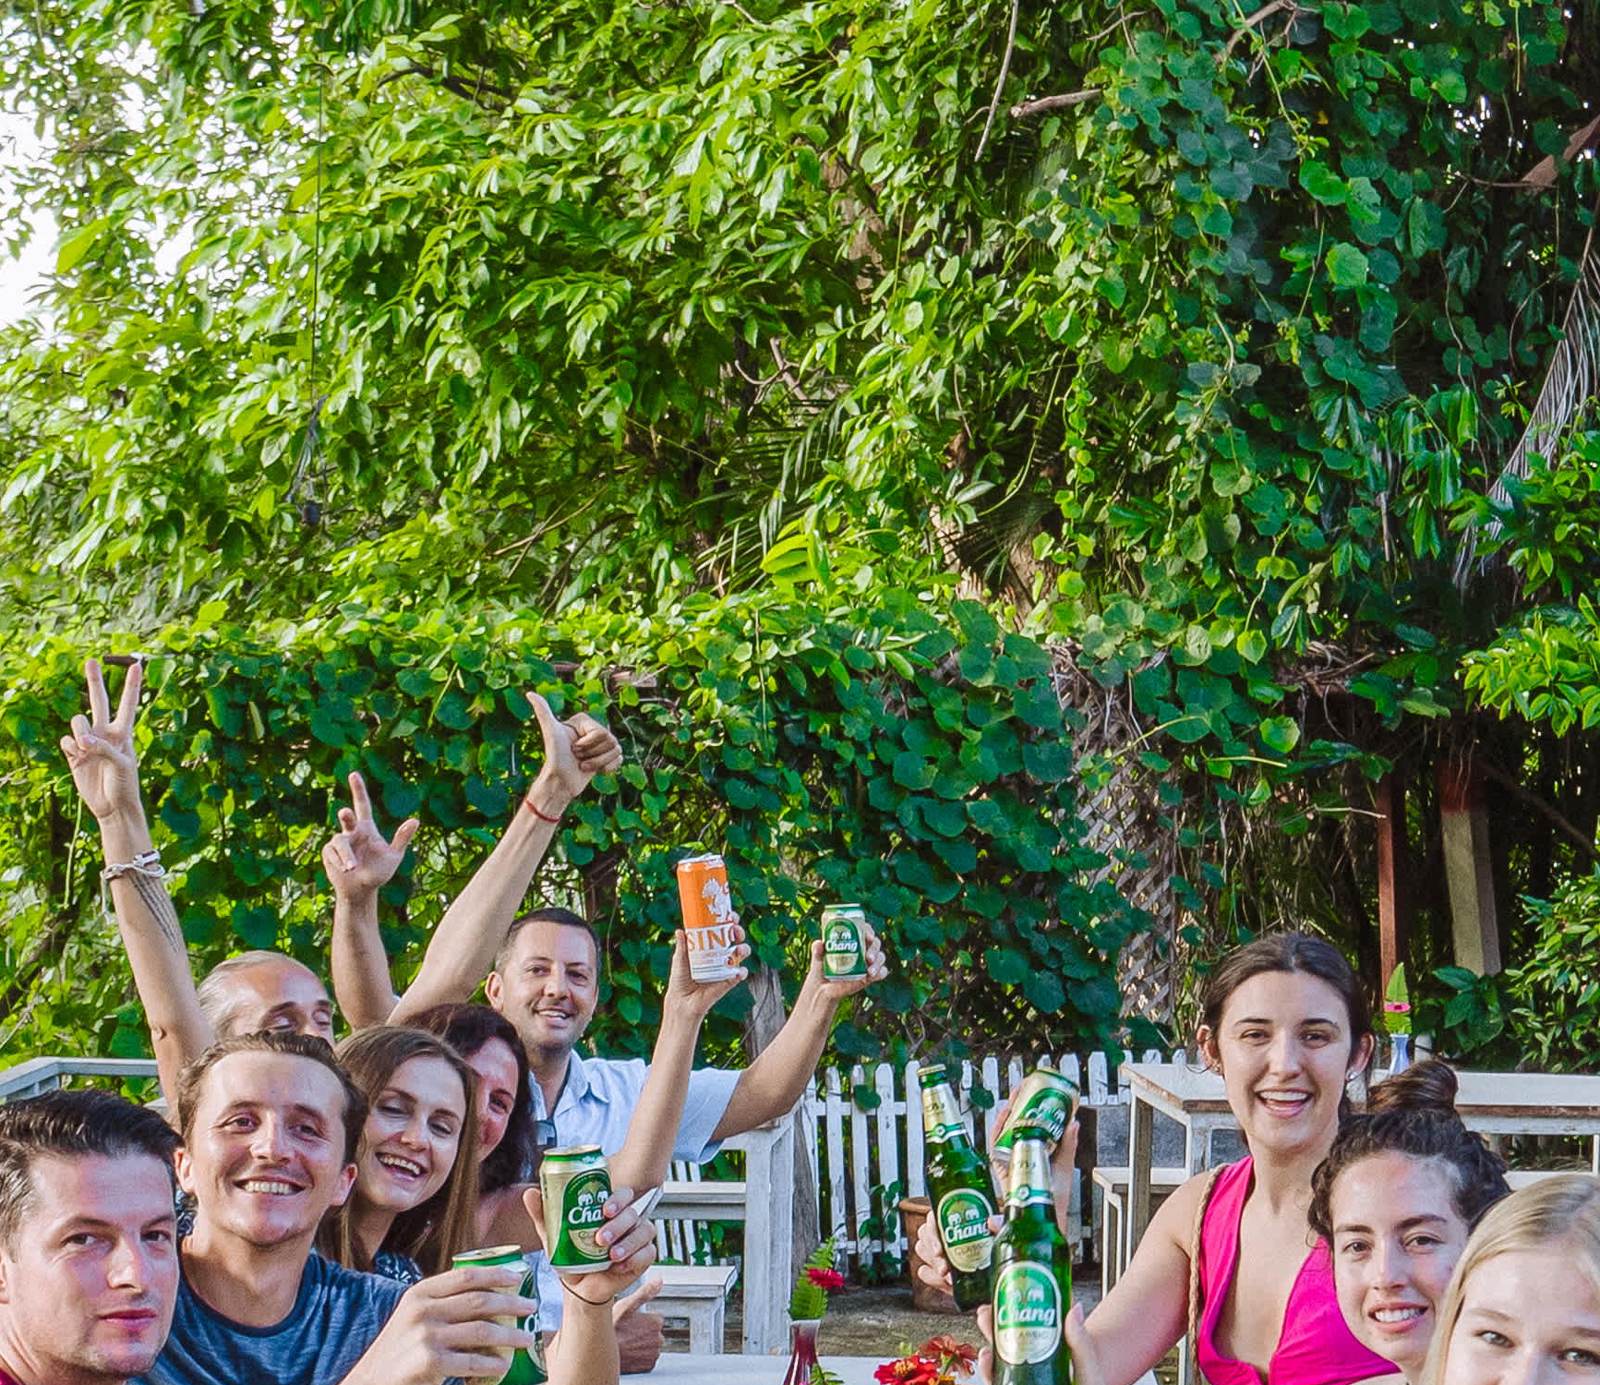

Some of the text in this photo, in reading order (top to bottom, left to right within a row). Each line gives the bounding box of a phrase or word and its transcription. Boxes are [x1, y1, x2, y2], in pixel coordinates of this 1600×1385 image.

[825, 940, 858, 953] Chang
[568, 1205, 603, 1224] Cha
[998, 1303, 1056, 1326] Chang
